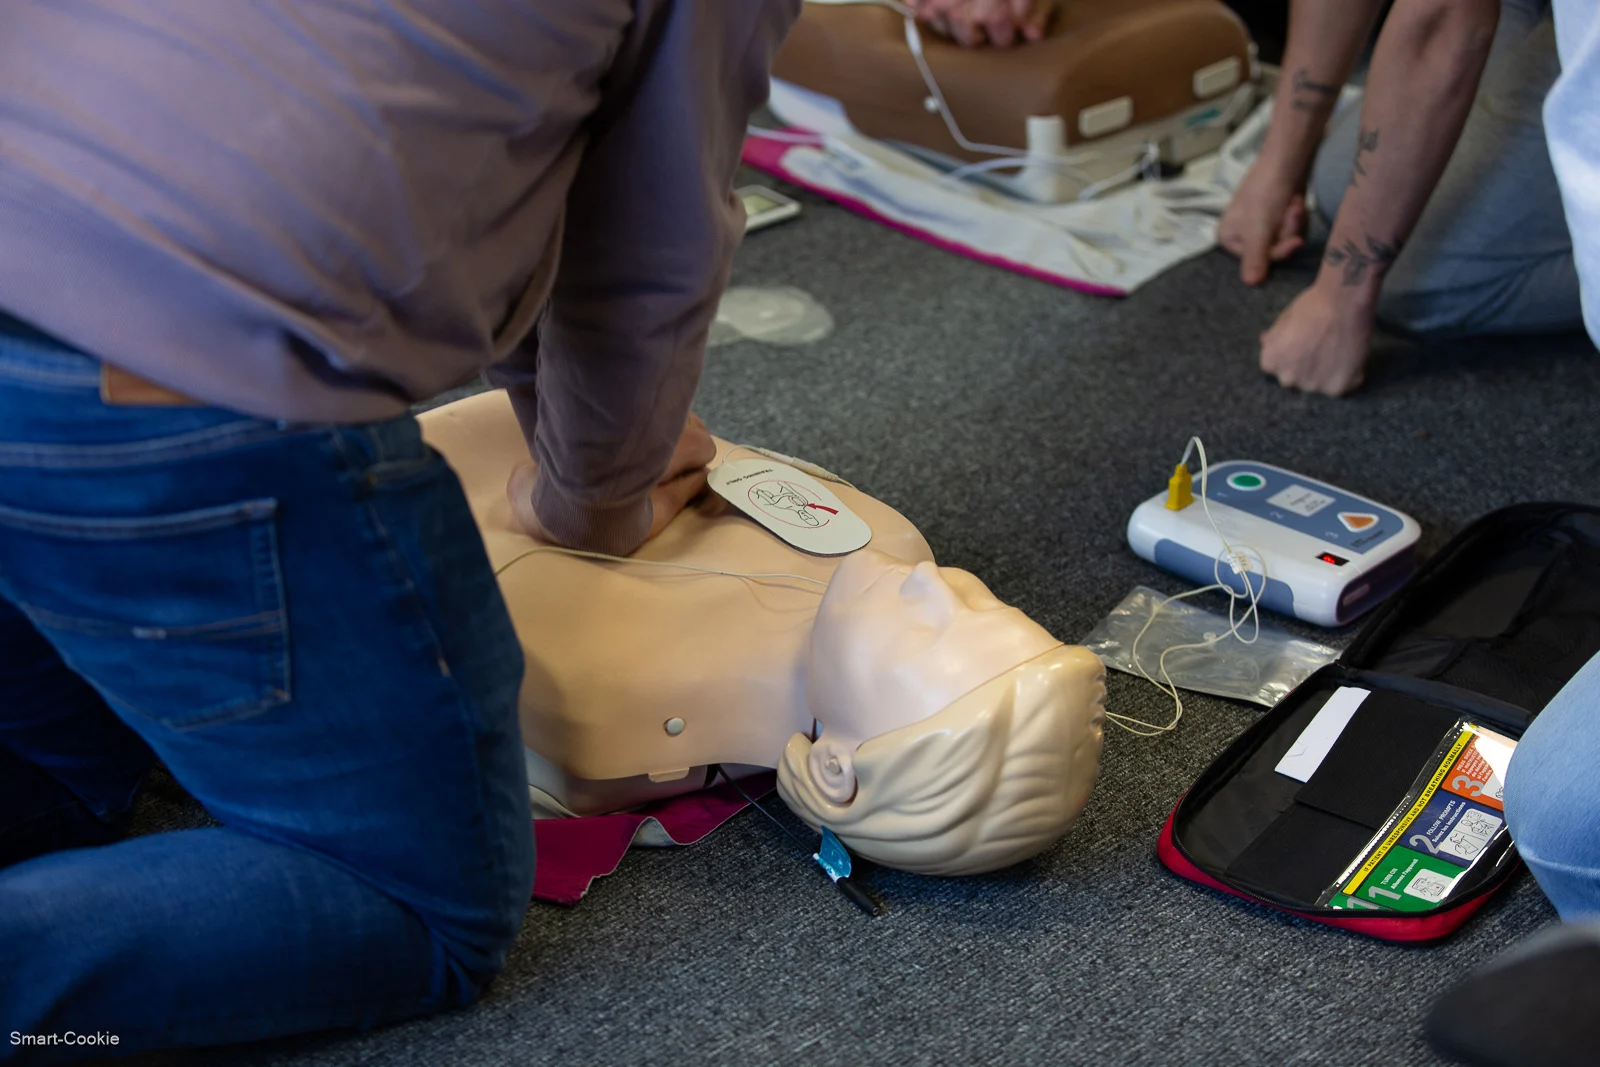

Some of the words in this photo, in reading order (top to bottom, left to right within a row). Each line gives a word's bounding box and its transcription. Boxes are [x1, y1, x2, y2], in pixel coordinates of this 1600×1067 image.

[1418, 798, 1428, 808] NOT
[1425, 769, 1445, 796] BREATHING
[1444, 743, 1462, 768] NORMALLY
[1452, 775, 1484, 797] 3
[1426, 820, 1441, 835] FOLLOW
[1439, 800, 1456, 820] PROMPTS
[1410, 834, 1440, 854] 2
[1368, 886, 1401, 900] 1
